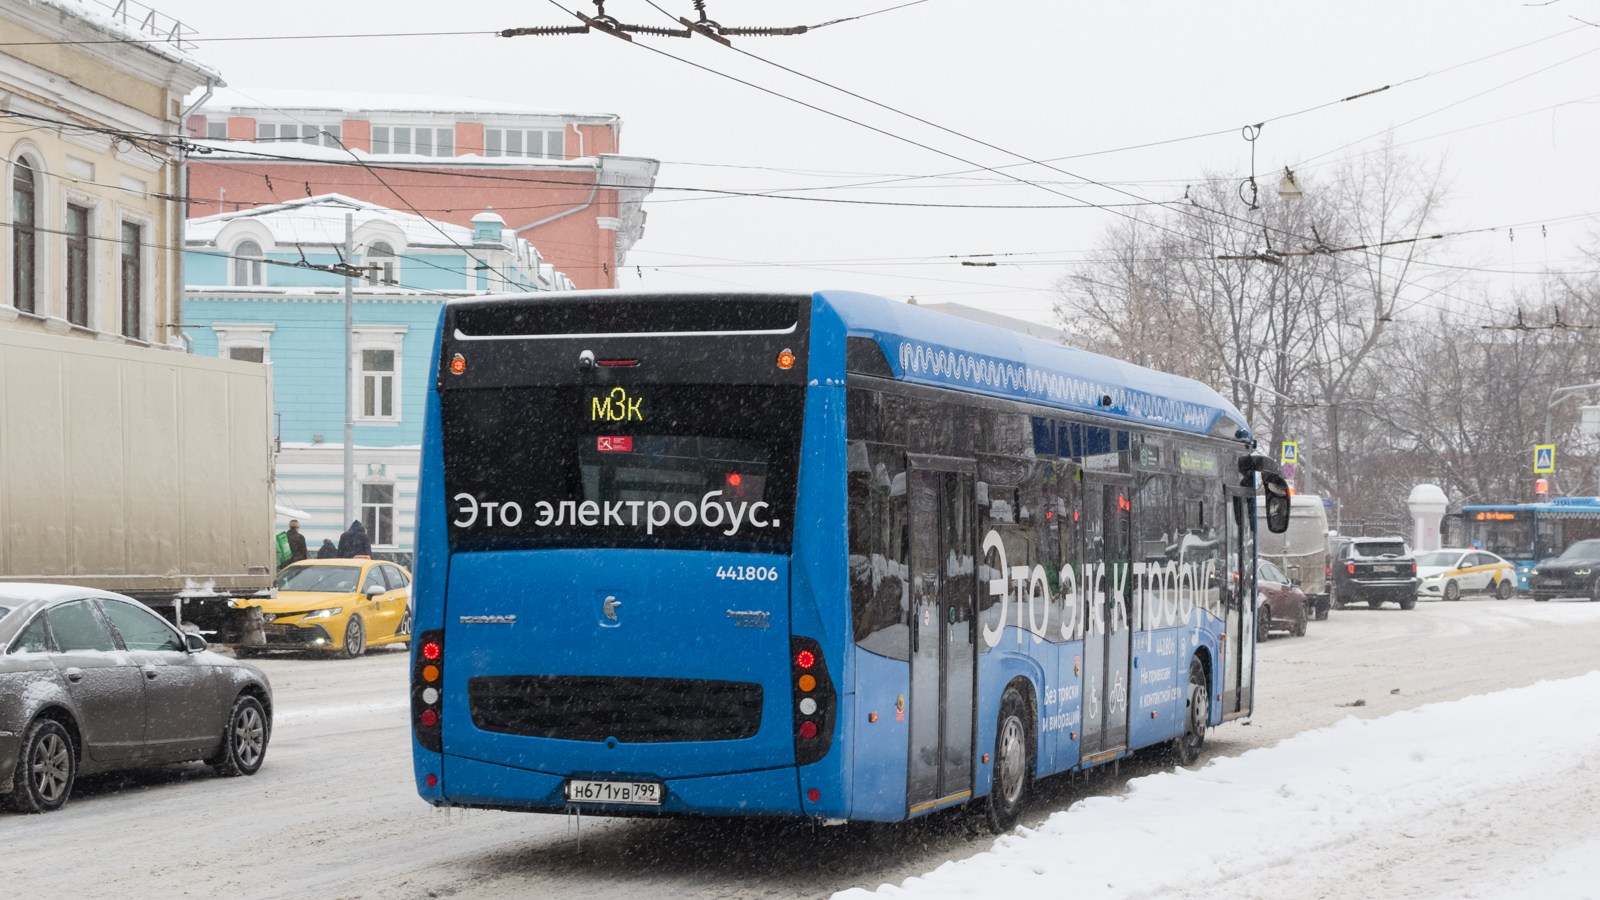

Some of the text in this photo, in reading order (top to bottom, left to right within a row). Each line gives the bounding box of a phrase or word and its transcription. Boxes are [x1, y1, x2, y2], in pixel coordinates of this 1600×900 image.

[453, 490, 781, 536] Это электробус.
[716, 566, 779, 581] 441806
[983, 529, 1049, 648] Это
[1044, 685, 1057, 705] Без
[1049, 705, 1080, 732] вибраций
